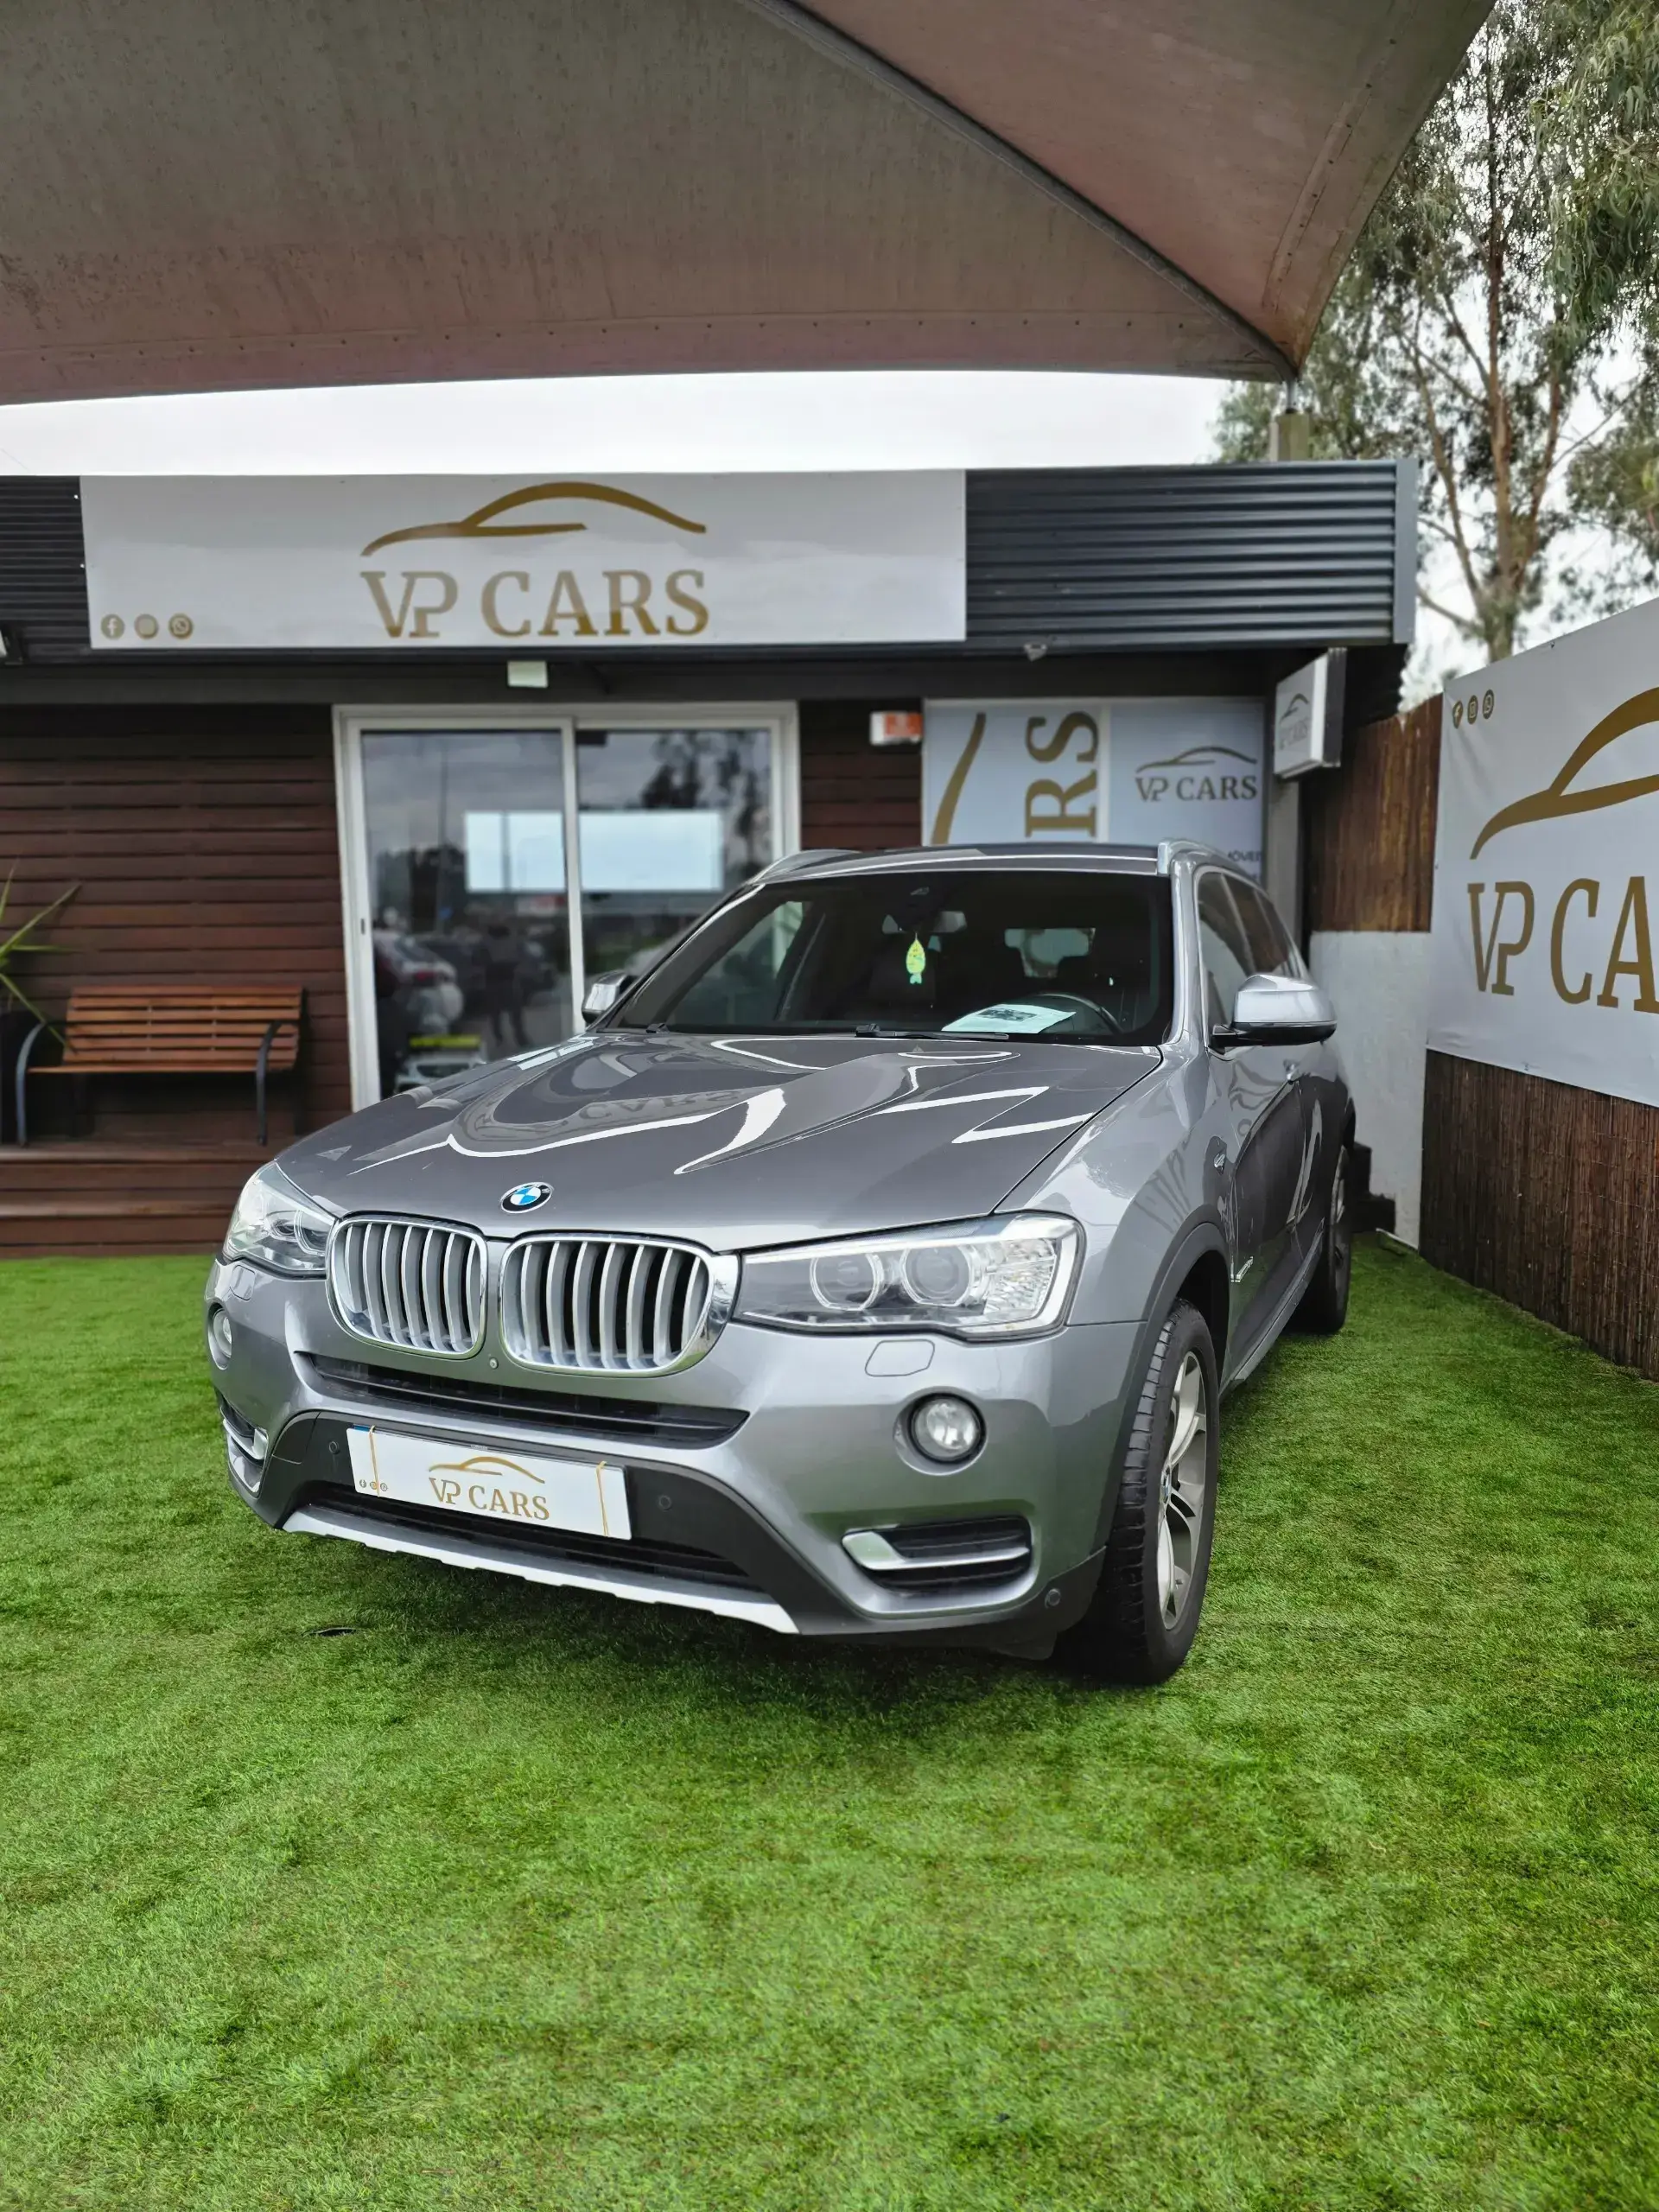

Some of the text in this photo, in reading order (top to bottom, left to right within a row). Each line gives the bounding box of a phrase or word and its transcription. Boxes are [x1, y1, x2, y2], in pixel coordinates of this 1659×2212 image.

[359, 569, 710, 639] VP CARS
[1135, 775, 1258, 802] VP CARS
[1467, 881, 1535, 996] VP
[429, 1477, 550, 1521] VP CARS
